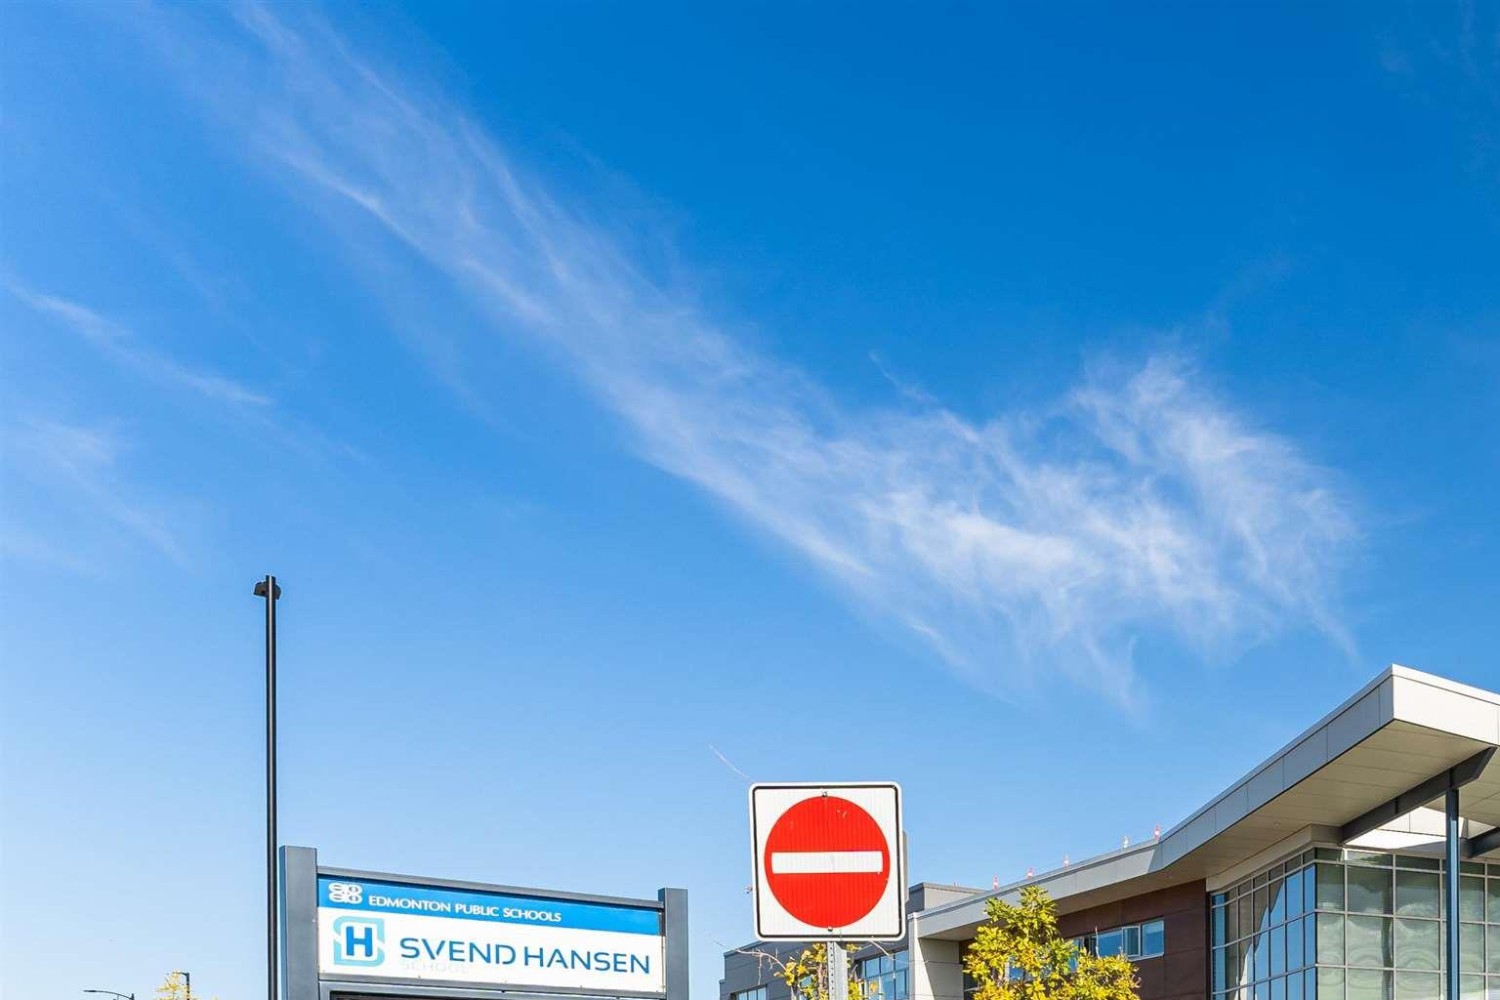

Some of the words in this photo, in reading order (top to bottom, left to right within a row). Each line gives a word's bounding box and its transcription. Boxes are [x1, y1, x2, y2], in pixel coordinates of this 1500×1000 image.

[369, 896, 451, 912] EDMONTON
[455, 904, 500, 917] PUBLIC
[503, 907, 562, 922] SCHOOLS
[400, 937, 517, 965] SVEND
[524, 946, 650, 974] HANSEN
